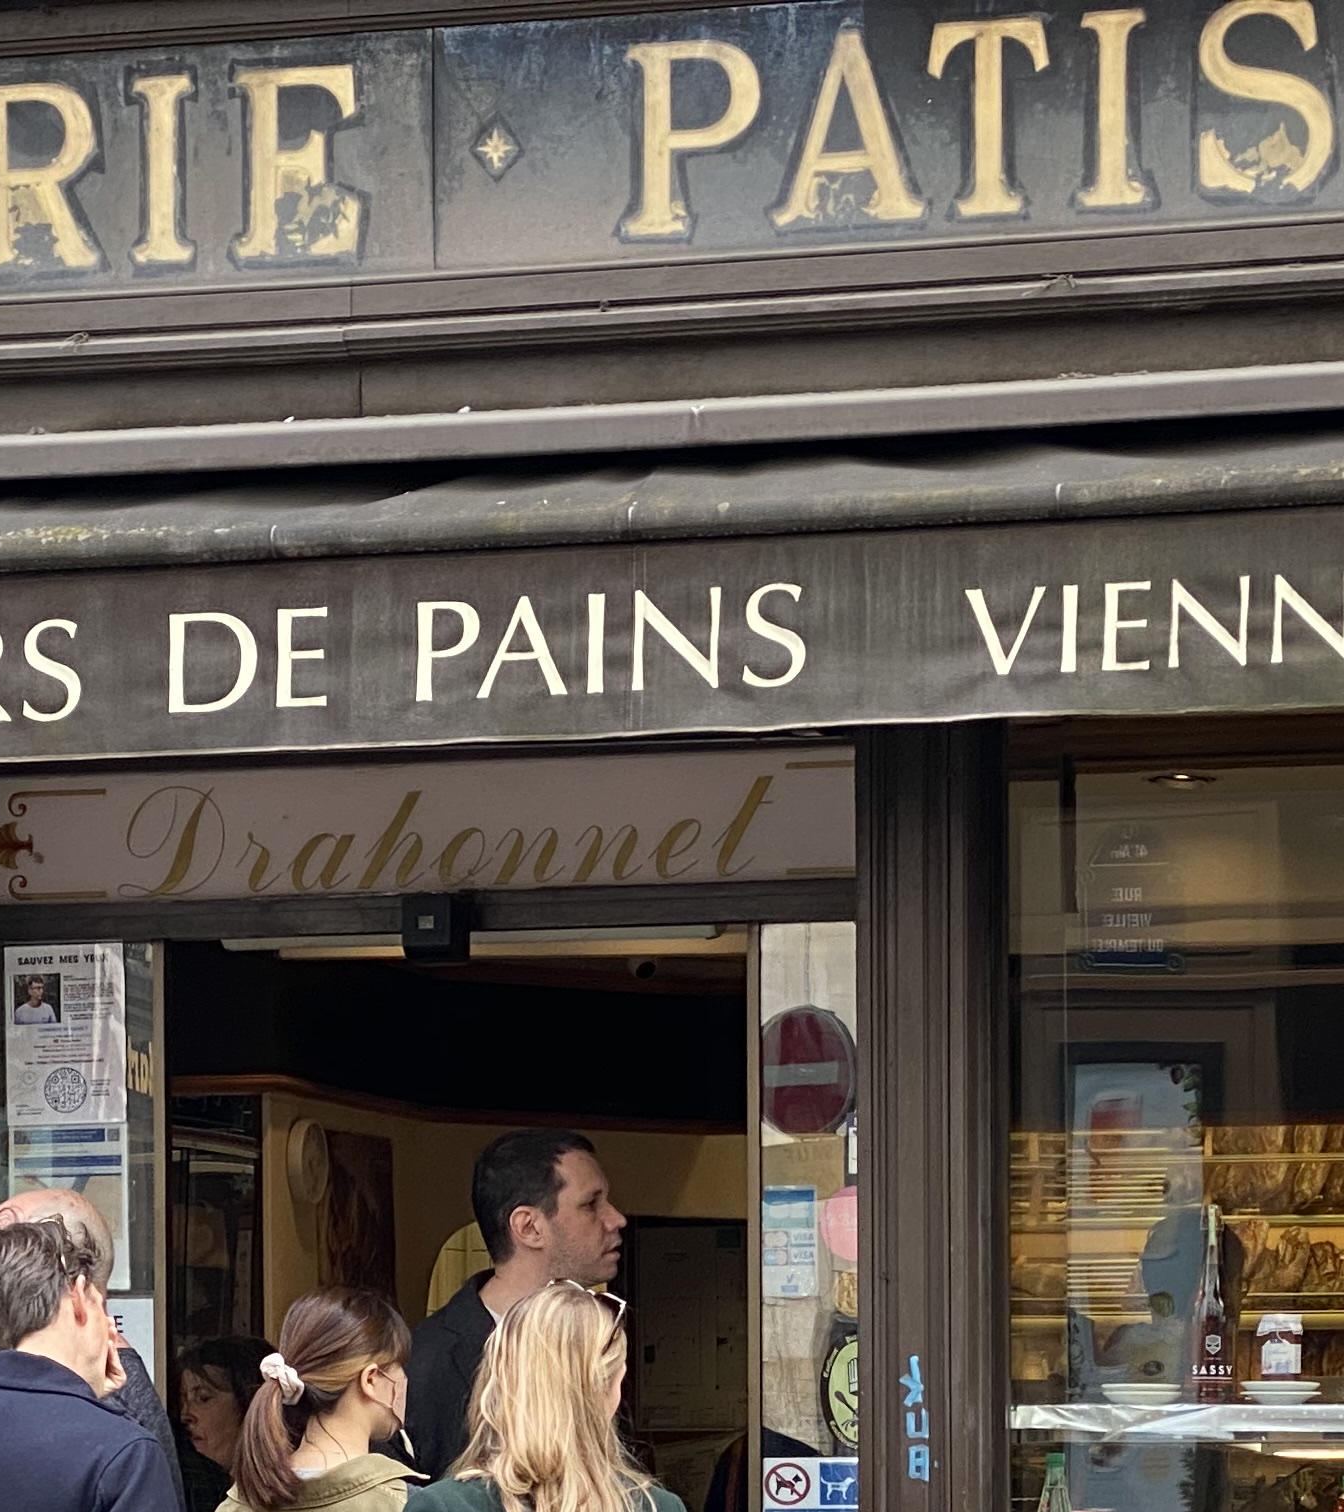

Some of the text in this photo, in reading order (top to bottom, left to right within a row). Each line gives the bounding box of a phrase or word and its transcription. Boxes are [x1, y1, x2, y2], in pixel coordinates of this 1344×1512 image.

[168, 606, 329, 714] DE
[414, 583, 807, 702] PAINS
[117, 775, 774, 899] Drahonnet
[1192, 1365, 1233, 1375] SASSY
